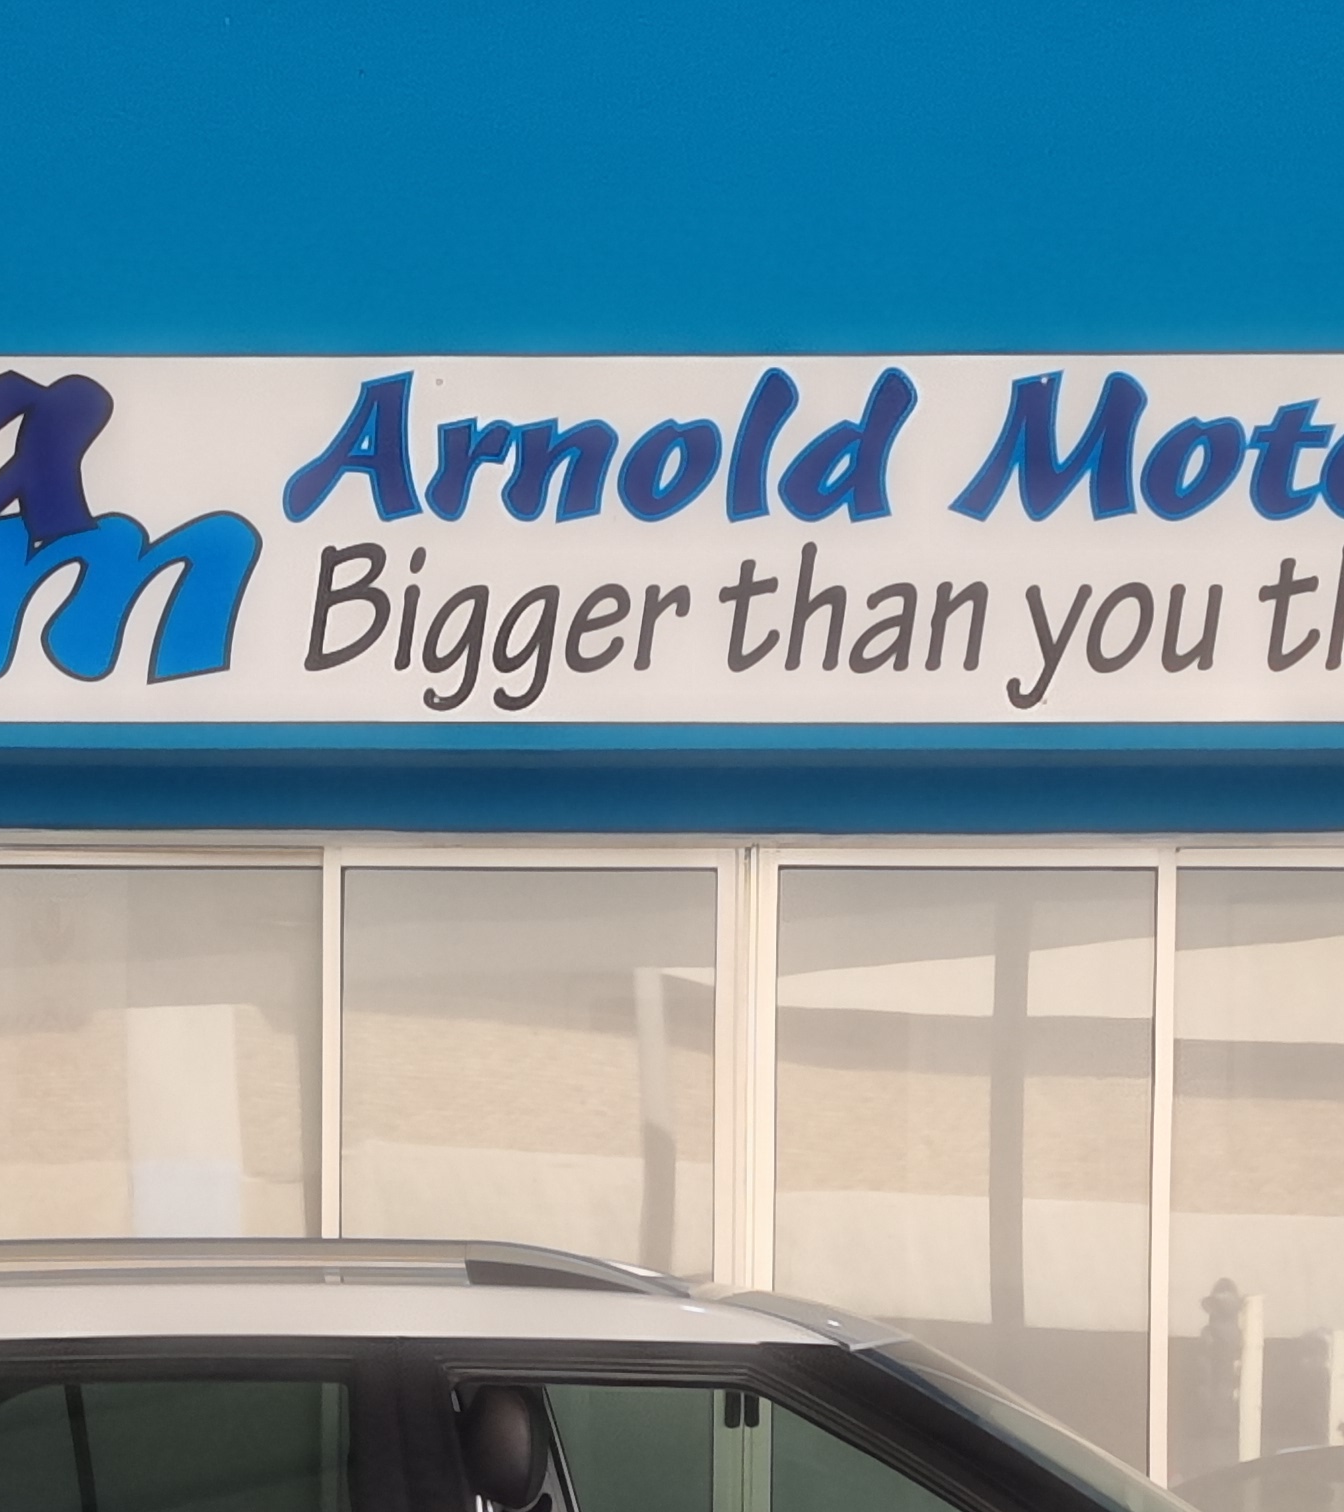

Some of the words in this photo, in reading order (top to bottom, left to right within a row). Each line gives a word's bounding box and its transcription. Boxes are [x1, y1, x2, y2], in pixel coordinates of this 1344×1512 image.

[283, 366, 919, 524] Arnold
[303, 542, 691, 711] Bigger
[718, 541, 990, 674] than
[1006, 581, 1224, 709] you
